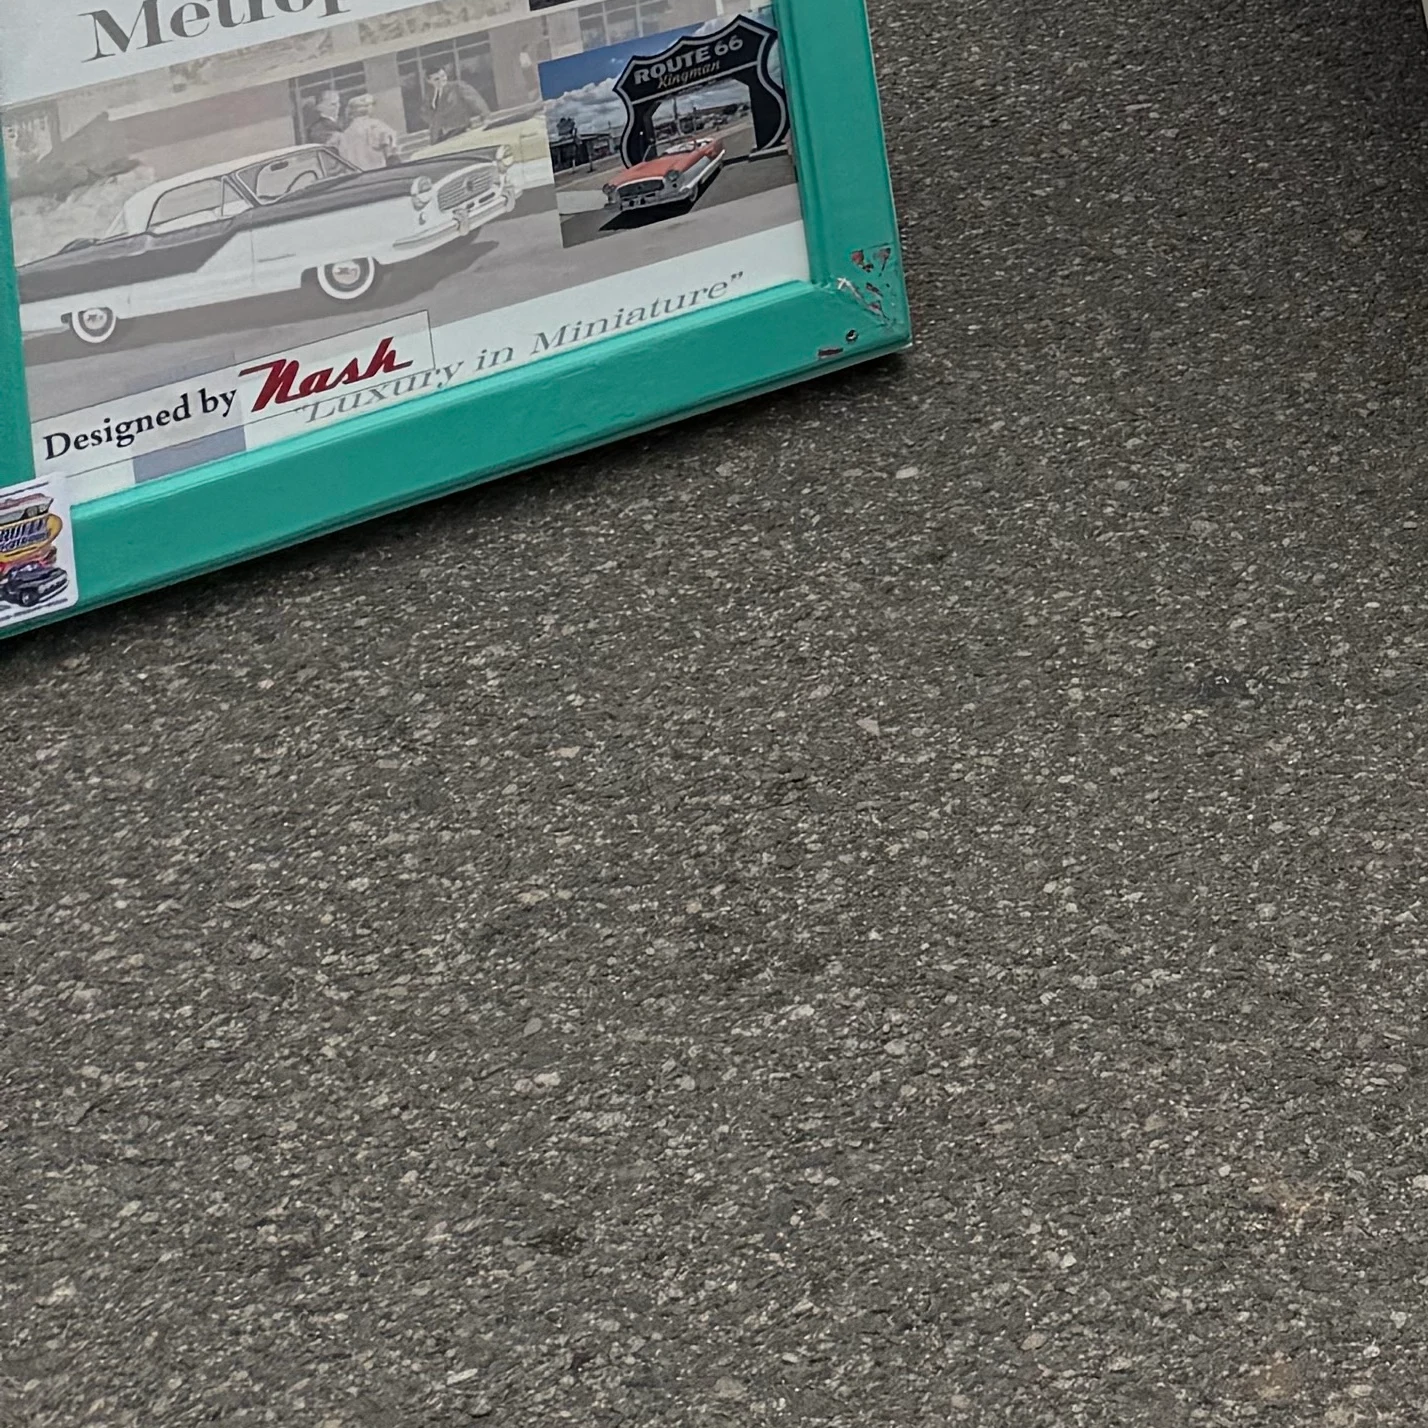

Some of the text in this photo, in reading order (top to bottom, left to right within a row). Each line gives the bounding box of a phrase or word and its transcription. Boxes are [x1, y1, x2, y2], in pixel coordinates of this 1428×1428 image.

[634, 34, 744, 84] ROUTE 66
[657, 61, 721, 90] Kingman
[473, 344, 515, 372] in
[530, 271, 743, 353] Miniature"
[43, 337, 412, 460] Designed by Nash
